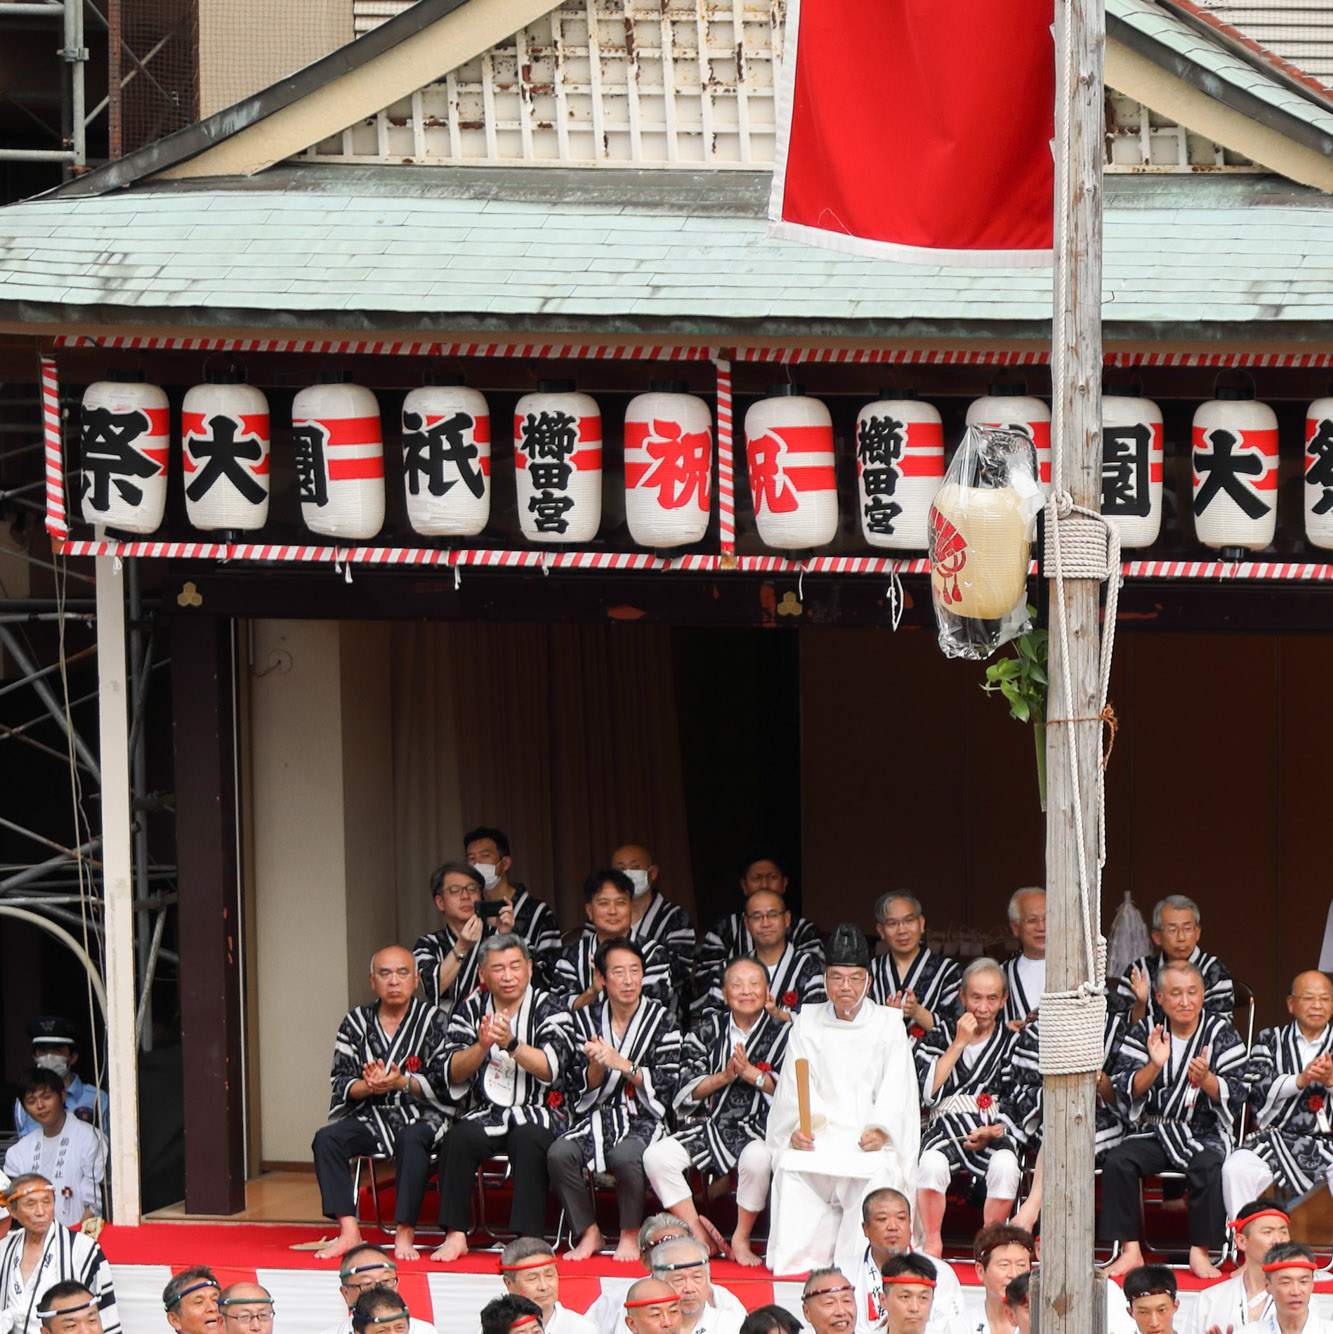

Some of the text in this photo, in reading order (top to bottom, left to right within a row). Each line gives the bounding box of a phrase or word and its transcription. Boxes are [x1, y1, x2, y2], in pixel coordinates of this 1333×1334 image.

[80, 407, 164, 511] 祭
[185, 415, 269, 505] 大
[519, 410, 578, 535] 櫛田宮
[643, 419, 712, 512] 祝
[1194, 429, 1272, 520] 大
